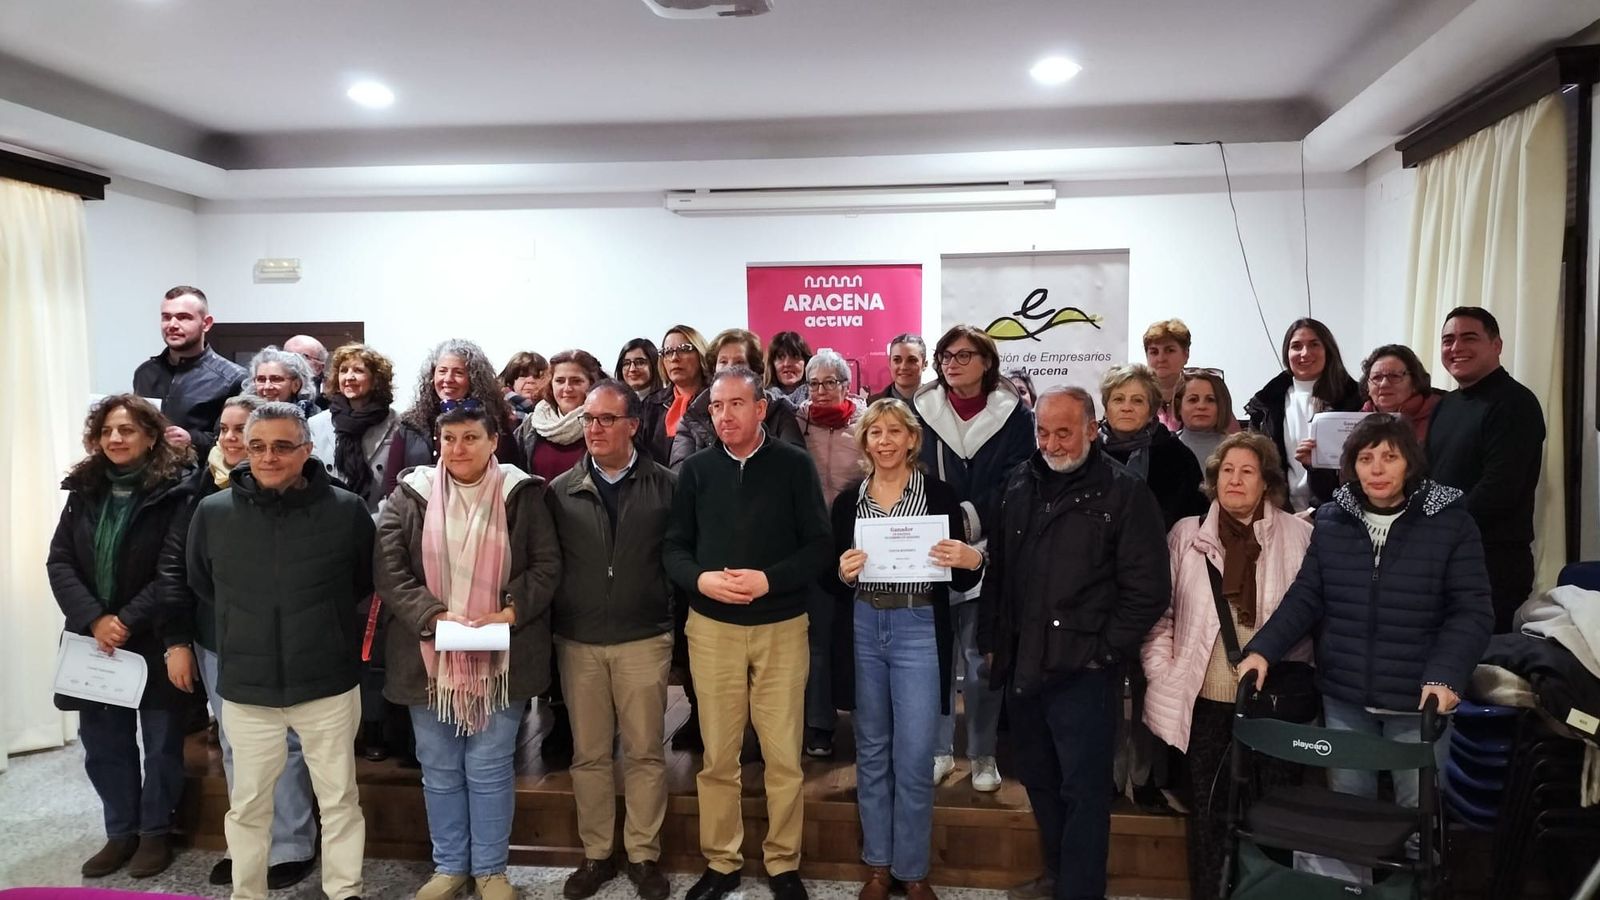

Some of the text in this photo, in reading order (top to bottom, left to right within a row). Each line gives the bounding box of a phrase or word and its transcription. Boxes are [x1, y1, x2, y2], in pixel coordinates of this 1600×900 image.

[783, 293, 885, 312] ARACENA
[804, 315, 863, 328] activa
[1022, 353, 1037, 363] de
[1040, 351, 1112, 364] Empresarios
[1021, 366, 1069, 376] Aracena
[1292, 739, 1331, 753] playcare
